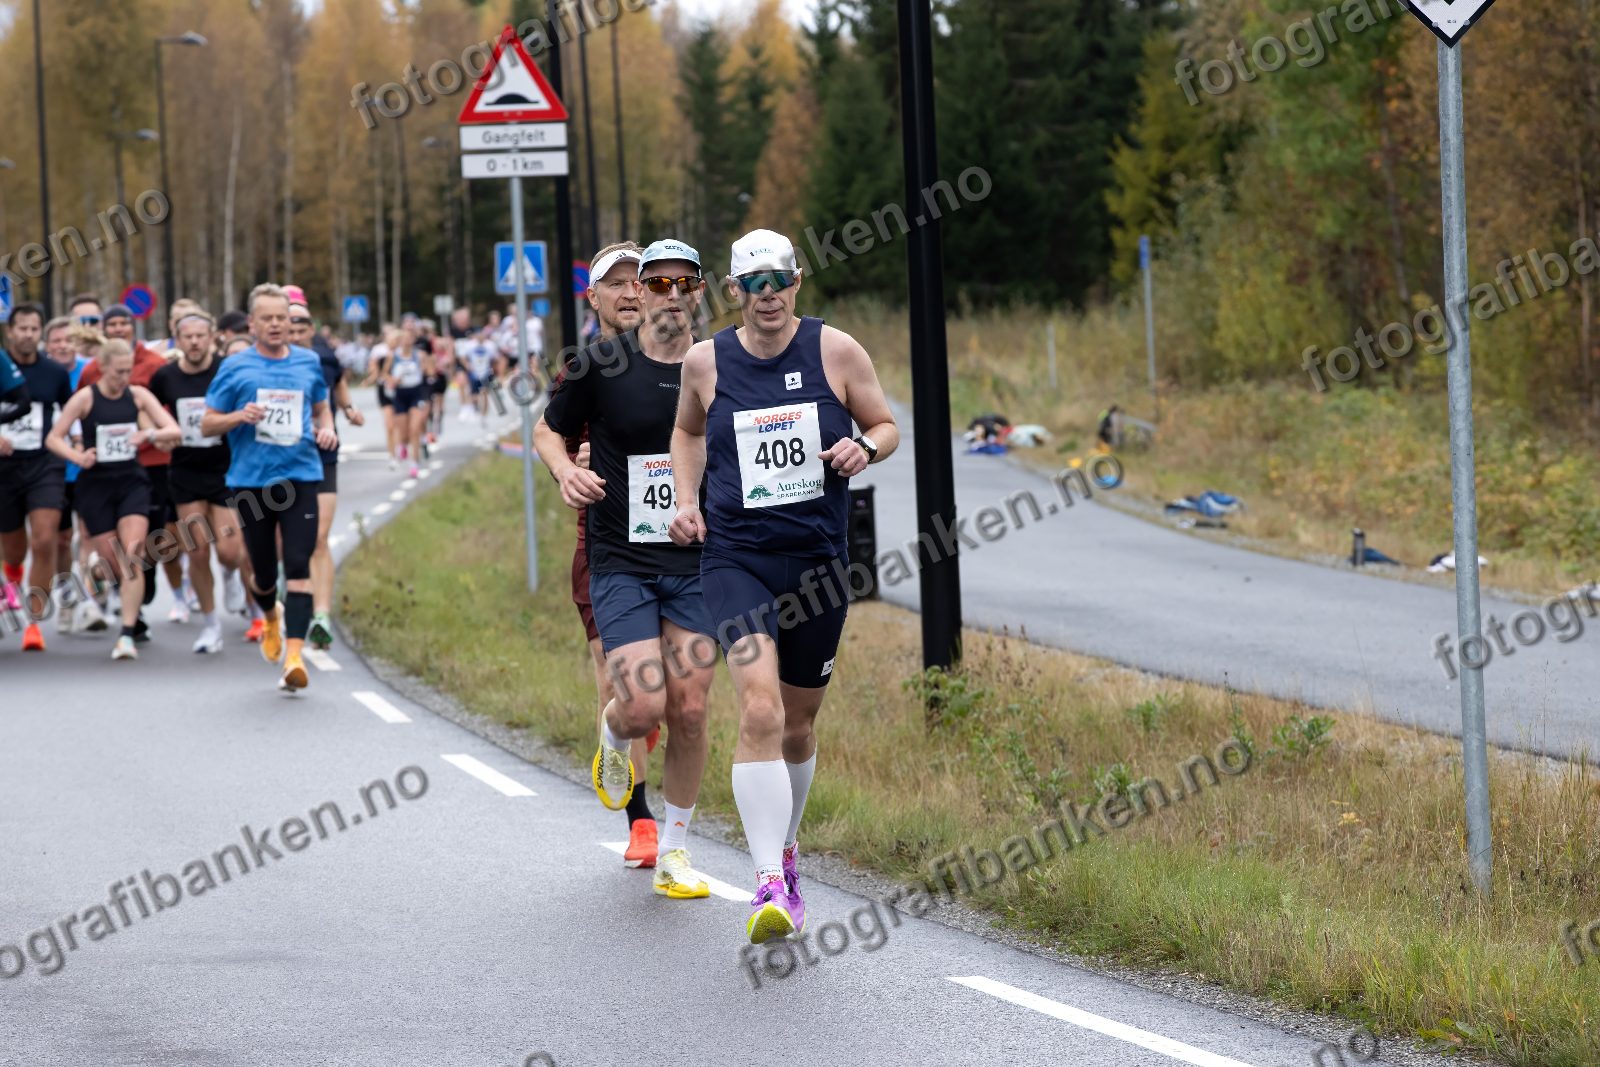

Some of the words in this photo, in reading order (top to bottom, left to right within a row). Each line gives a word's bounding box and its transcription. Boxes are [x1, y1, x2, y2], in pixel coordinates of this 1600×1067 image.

[482, 129, 545, 145] Gangfelt
[486, 158, 498, 172] 0
[264, 405, 292, 425] 721
[753, 411, 802, 425] NORGES
[758, 421, 795, 433] LØPET
[755, 437, 806, 469] 408
[777, 479, 822, 492] Aurskog
[643, 483, 676, 509] 49
